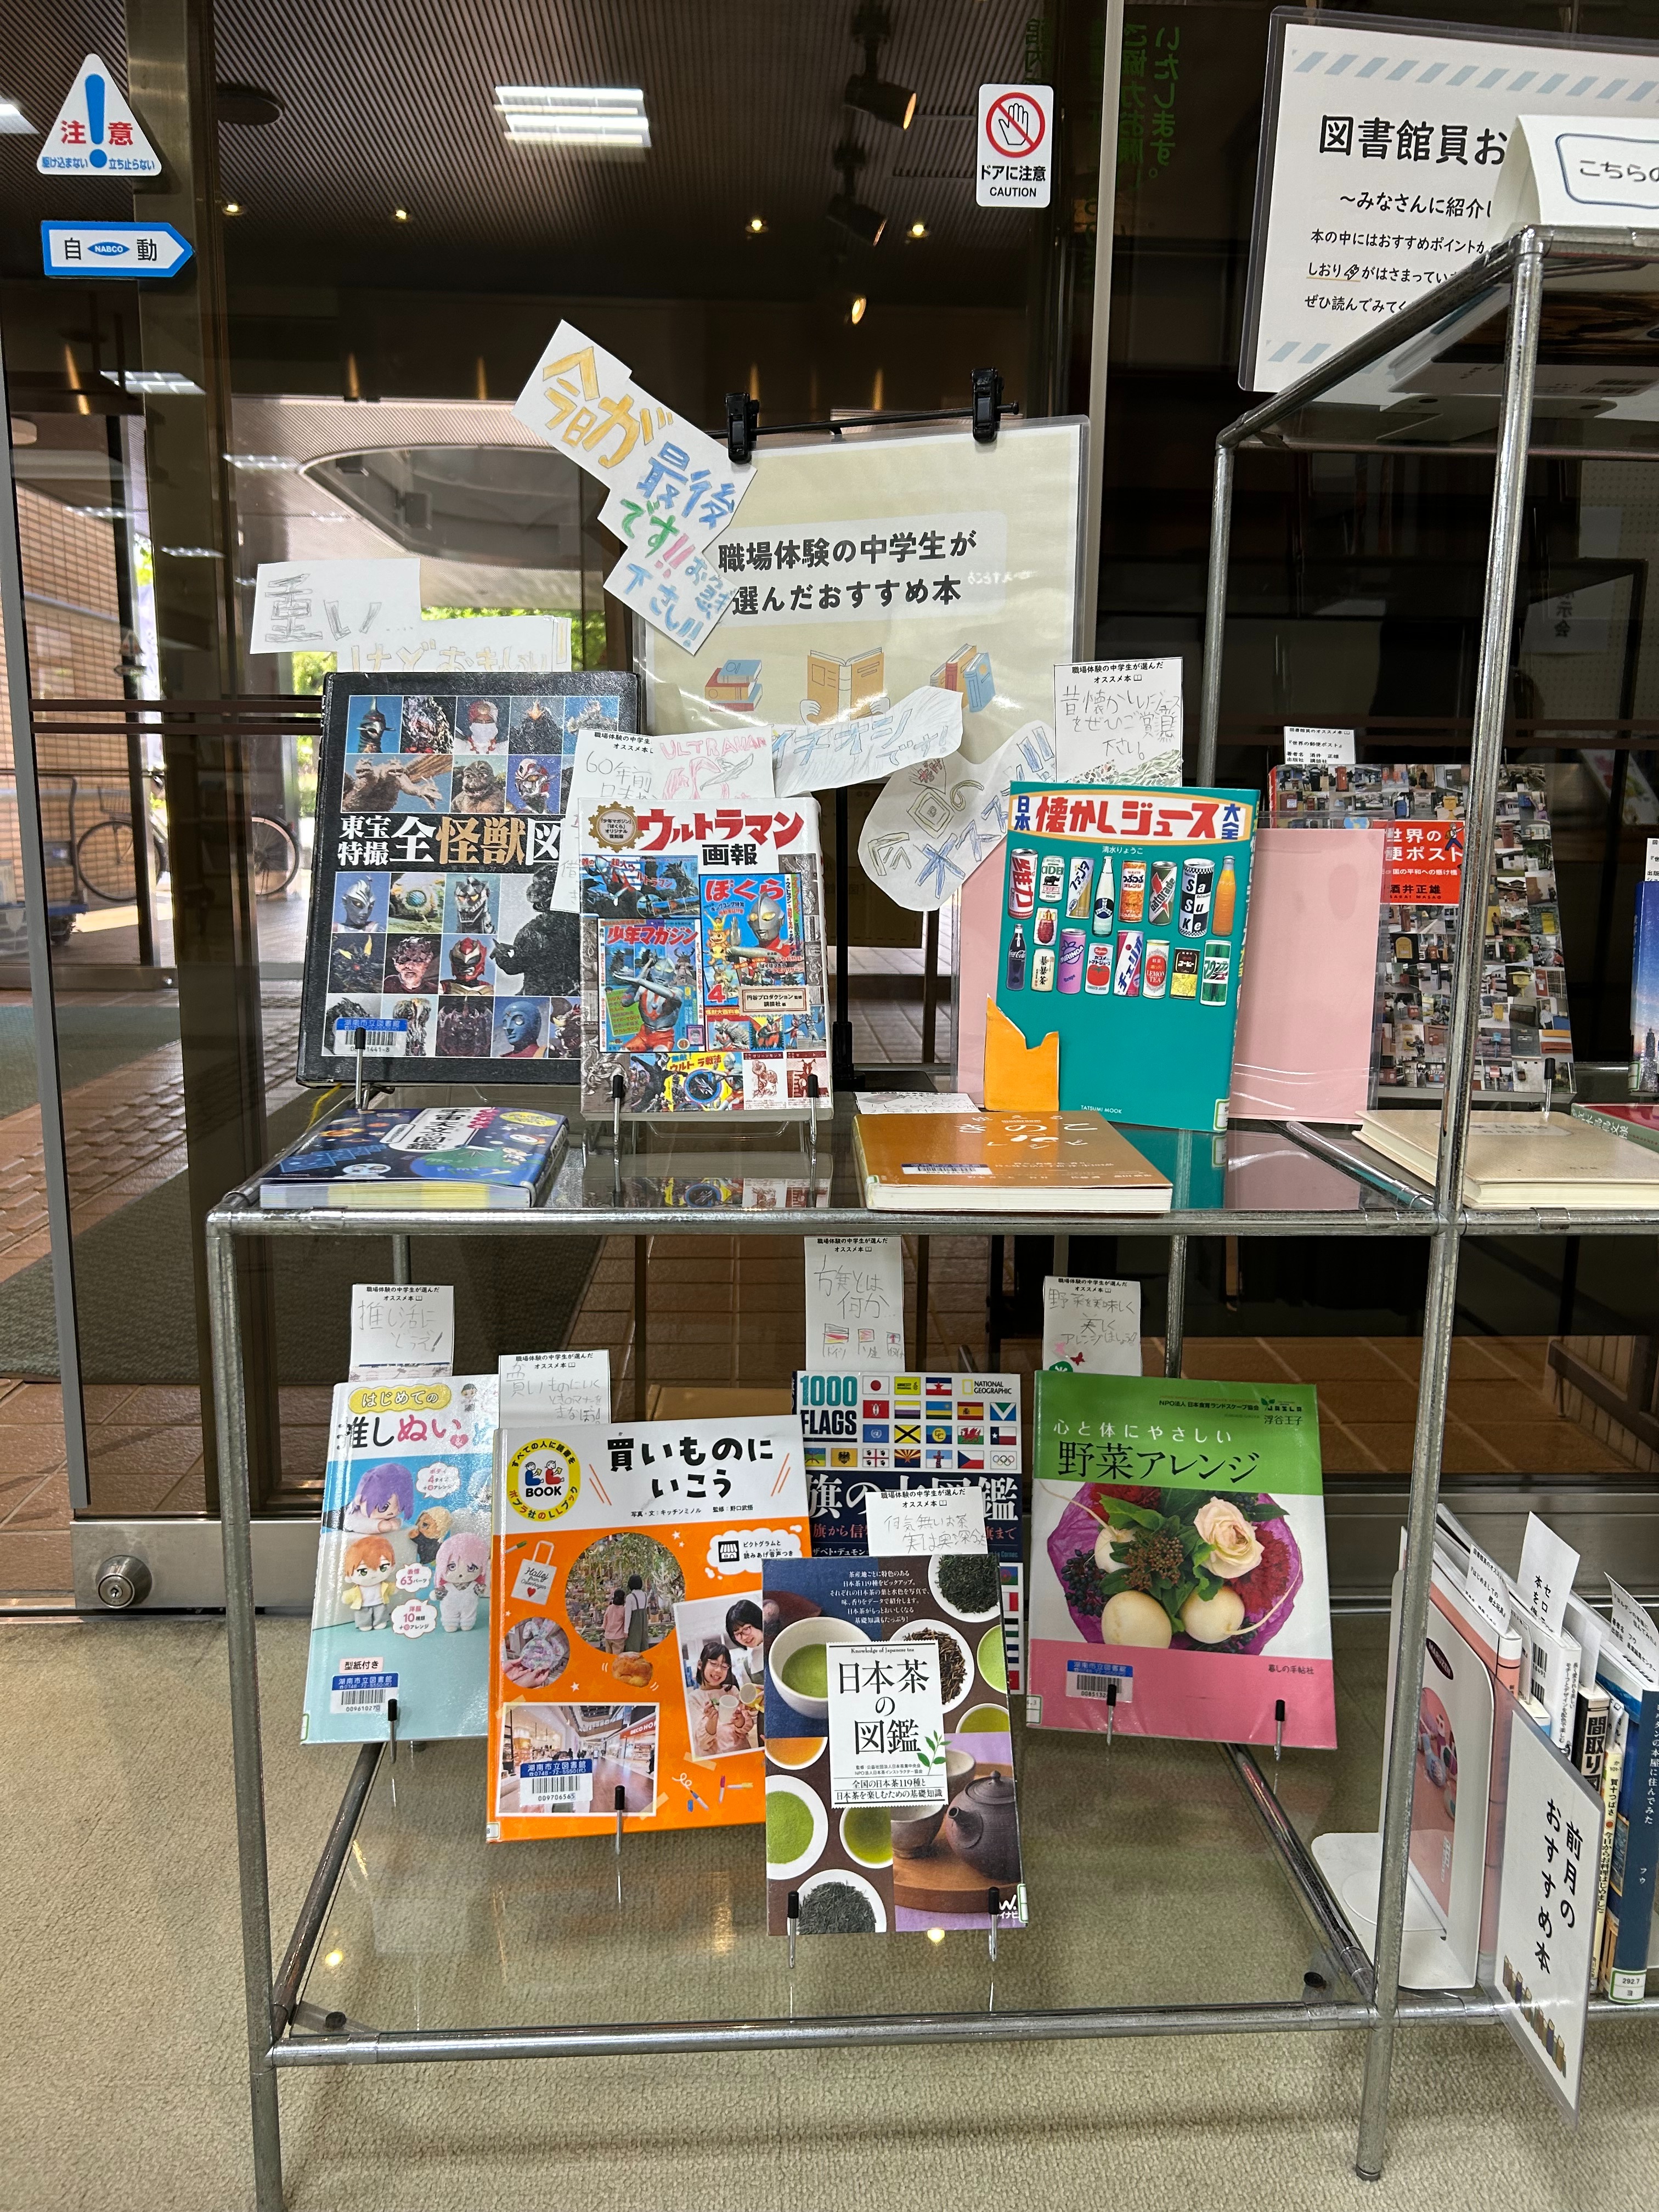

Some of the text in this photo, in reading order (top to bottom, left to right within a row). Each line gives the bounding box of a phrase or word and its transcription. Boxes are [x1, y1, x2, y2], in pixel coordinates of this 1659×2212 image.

[60, 120, 133, 145] 注 意
[1319, 115, 1508, 166] 図書館員お
[42, 156, 155, 171] 駆け込まない 立ち止らない
[1579, 159, 1659, 183] こちらの
[981, 165, 1046, 182] ドアに注意
[990, 187, 1036, 198] CAUTION
[65, 238, 157, 262] 自 動
[94, 245, 123, 253] NABCO
[1308, 263, 1340, 278] しおり
[543, 346, 673, 469] 今日が
[636, 442, 735, 529] 最後
[718, 529, 977, 573] 職場体験の中学生が
[732, 574, 961, 616] 選んだおすすめ本
[1072, 661, 1164, 674] 職場体験の中学生が選んだ
[1094, 675, 1131, 684] オススメ本
[594, 732, 652, 744] 職場体験の中学生
[660, 734, 768, 759] ULTRAMAN
[613, 743, 648, 753] オススメ本
[1014, 795, 1030, 830] 日本
[1036, 795, 1220, 839] 懐かしジュース
[1221, 803, 1240, 840] 大全
[341, 816, 391, 839] 東宝
[637, 809, 805, 851] ウルトラマン
[1386, 828, 1442, 844] 世界の
[390, 817, 562, 866] 全怪獣図
[1102, 845, 1143, 855] 清水りょうこ
[338, 841, 391, 866] 特撮
[702, 843, 758, 866] 画報
[706, 878, 785, 902] ぼくら
[1390, 884, 1442, 894] 酒井正雄
[607, 925, 699, 945] 少年マガジン
[708, 984, 726, 1003] 4
[1058, 1278, 1128, 1287] 職場体験の中学生が選んだ
[358, 1300, 437, 1331] 推し活に
[515, 1352, 594, 1363] 職場体験の中学生が選んだ
[534, 1362, 567, 1370] オススメ本
[800, 1375, 858, 1407] 1000
[974, 1380, 1004, 1388] NATIONAL
[974, 1387, 1012, 1395] GEOGRAPHIC
[362, 1391, 439, 1409] はじめての
[1188, 1401, 1260, 1411] 日本食育ランドスケープ協会
[801, 1410, 857, 1435] FLAGS
[1053, 1419, 1232, 1444] 心と体にやさしい
[607, 1436, 774, 1472] 買いものに
[1058, 1440, 1260, 1483] 野菜アレンジ
[526, 1486, 562, 1498] BOOK
[651, 1469, 732, 1499] いこう
[808, 1474, 1019, 1521] 旗の鑑
[881, 1488, 966, 1500] 職場体験の中学生が選んだ
[660, 1506, 702, 1516] キッチンミノル
[743, 1539, 782, 1548] ピクトグラムと
[743, 1550, 794, 1560] 読みあげ音声つき
[830, 1588, 930, 1597] それぞれの日本茶の葉と水色を写真で、
[841, 1597, 919, 1606] 味、香りをデータで紹介します。
[847, 1607, 915, 1615] 日本茶がもっとおいしくなる
[345, 1660, 379, 1671] 型紙付き
[1427, 1640, 1453, 1678] MARUZEN
[838, 1659, 930, 1695] 日本茶
[1268, 1663, 1315, 1675] 暮しの手帖社
[875, 1696, 895, 1718] の
[854, 1718, 922, 1755] 図鑑
[527, 1760, 586, 1773] 湖南市立図書館
[852, 1778, 927, 1789] 全国の日本茶119種と
[837, 1788, 943, 1801] 日本茶を楽しむための基礎知識
[1560, 1820, 1583, 1928] 前月の
[1534, 1799, 1561, 1975] おすすめ本
[1622, 1977, 1640, 1985] 292.7
